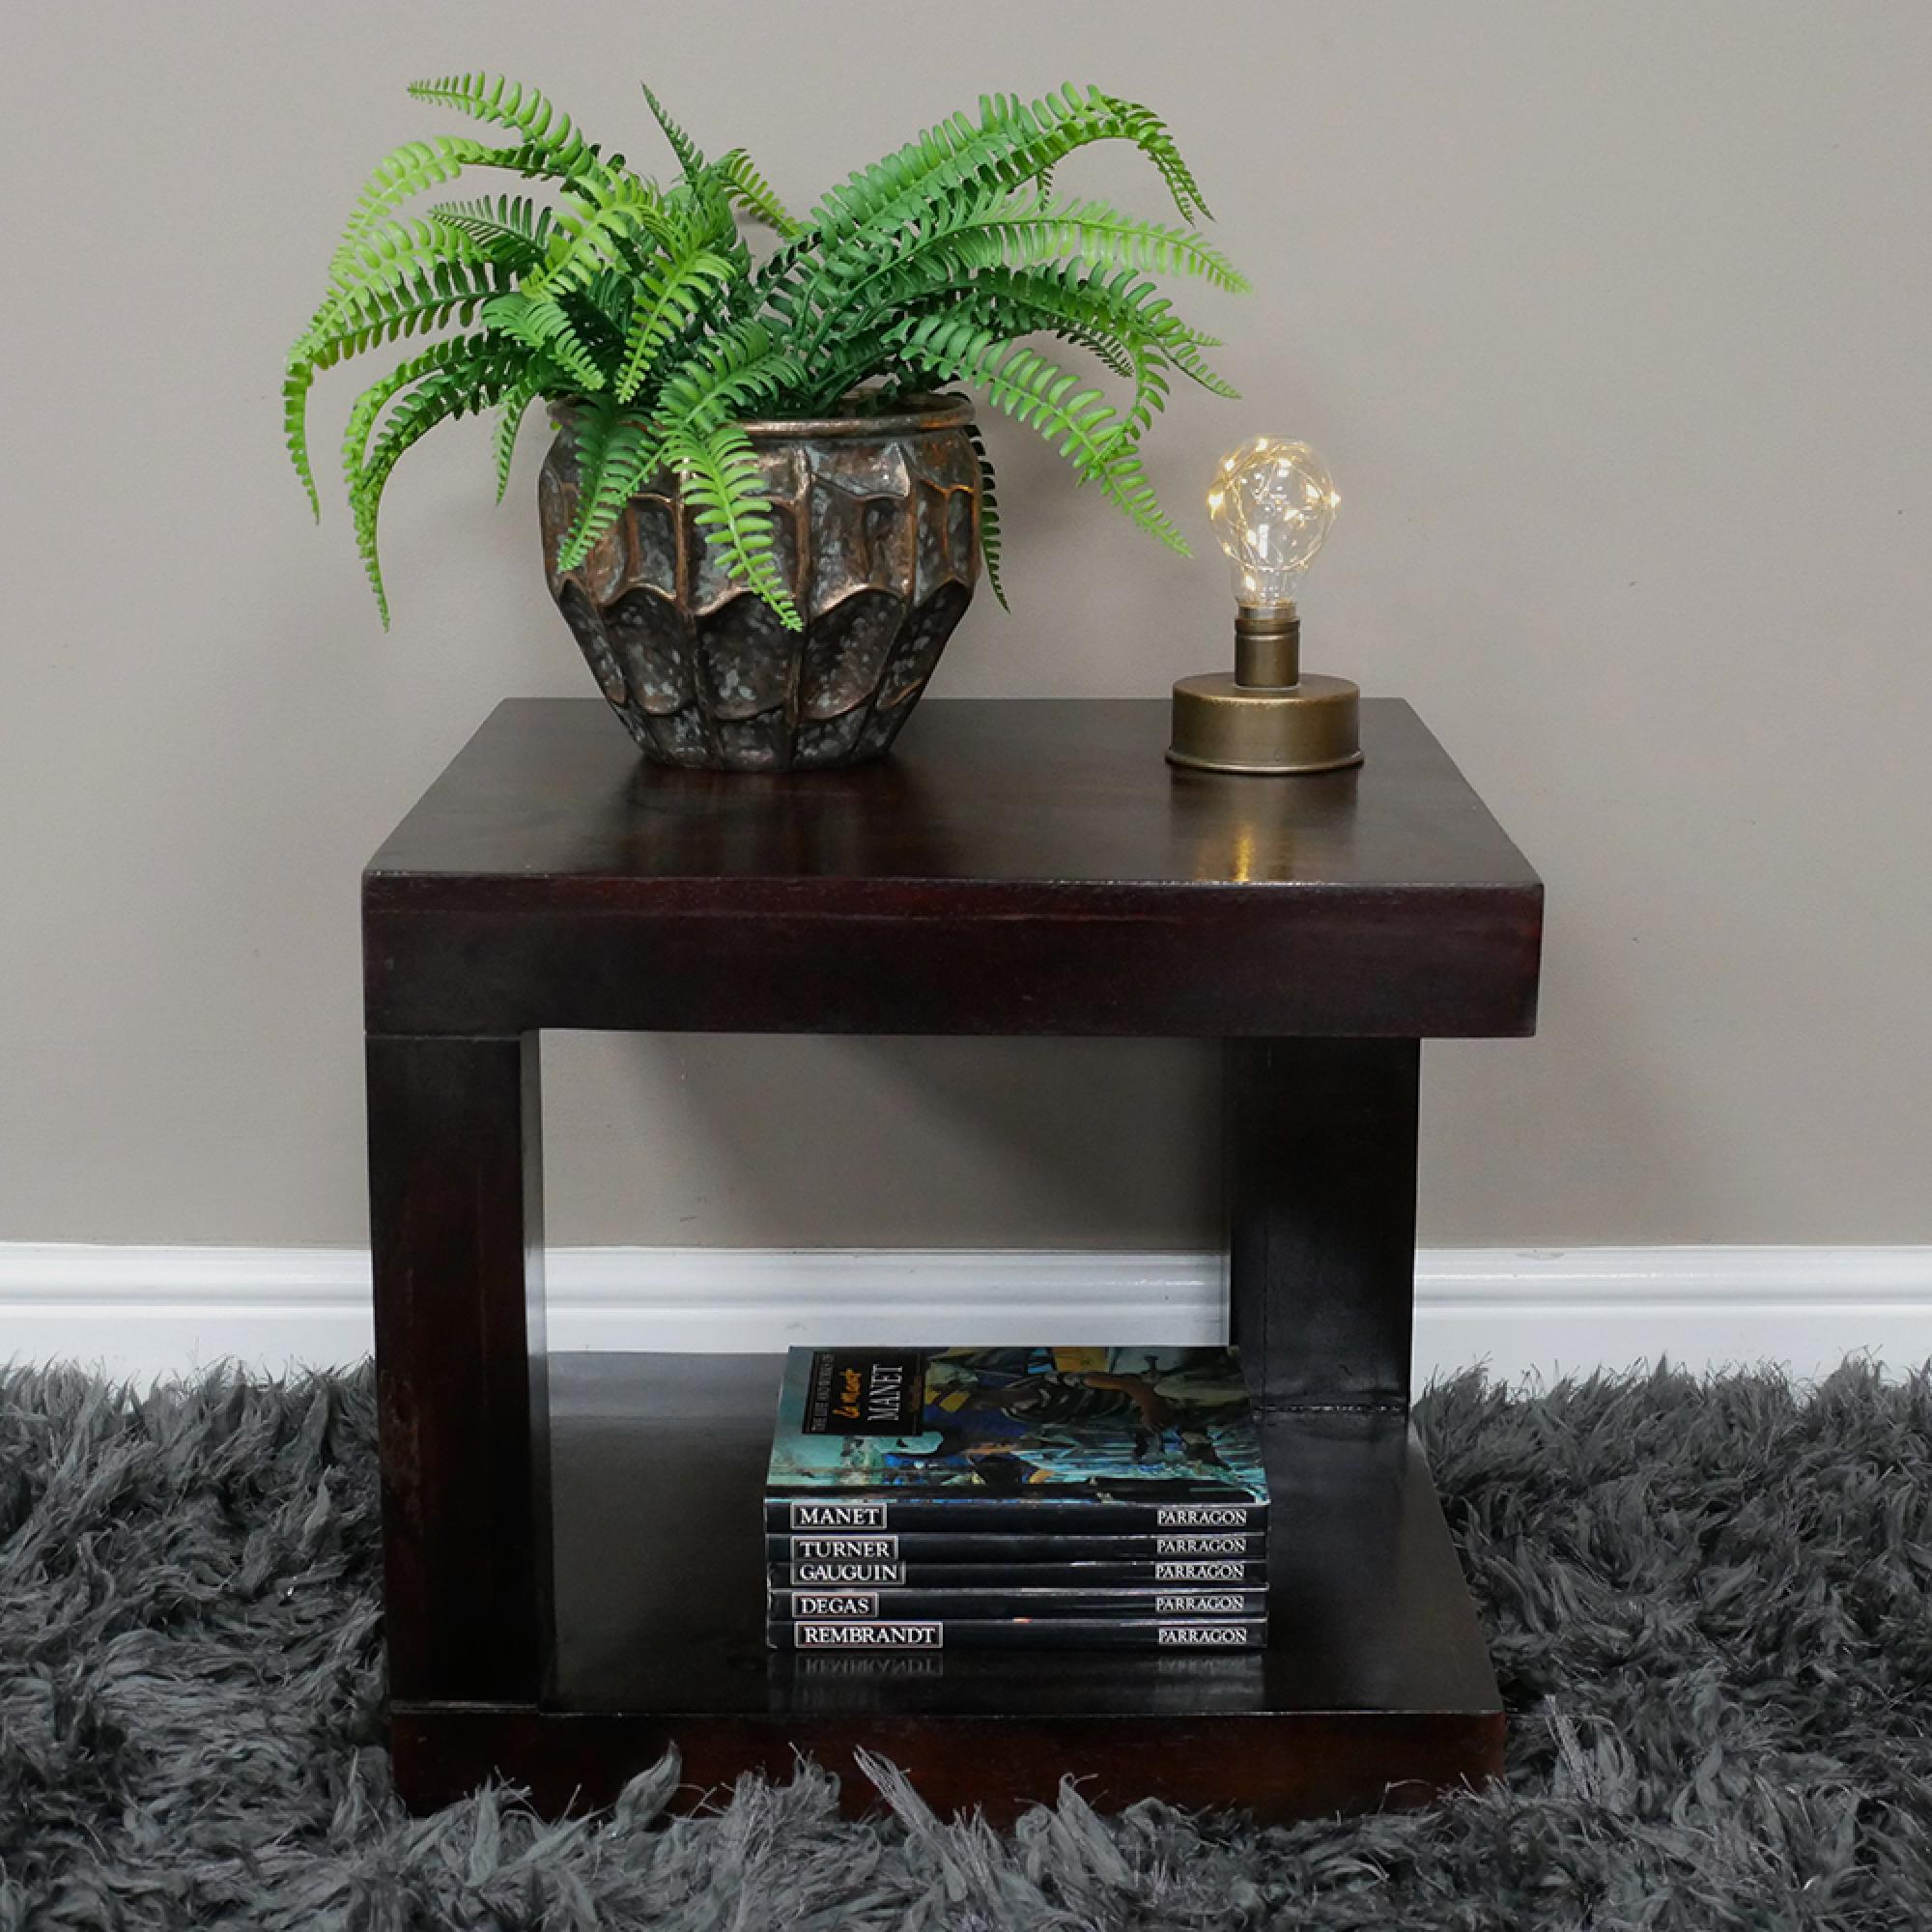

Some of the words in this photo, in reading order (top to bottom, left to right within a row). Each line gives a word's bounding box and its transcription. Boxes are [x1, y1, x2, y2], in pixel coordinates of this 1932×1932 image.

[867, 1363, 902, 1421] MANET
[799, 1507, 880, 1525] MANET
[1158, 1509, 1247, 1525] PARRAGON
[799, 1541, 891, 1557] TURNER
[1158, 1538, 1247, 1553] PARRAGON
[799, 1564, 897, 1581] GAUGUIN
[1156, 1564, 1245, 1579] PARRAGON
[801, 1598, 869, 1614] DEGAS
[1156, 1595, 1245, 1611] PARRAGON
[804, 1628, 936, 1643] REMBRANDT
[1158, 1628, 1247, 1643] PARRAGON
